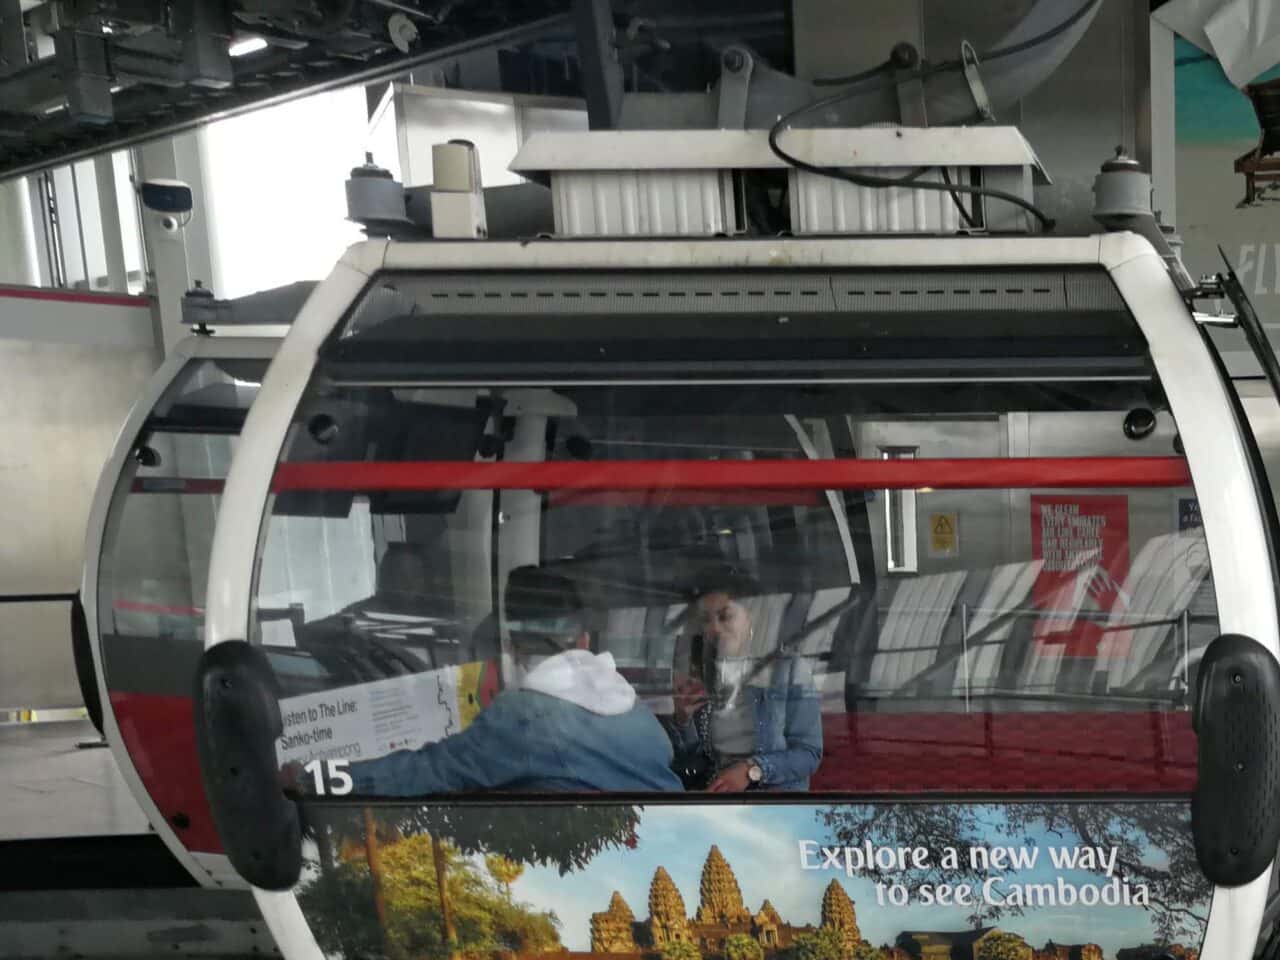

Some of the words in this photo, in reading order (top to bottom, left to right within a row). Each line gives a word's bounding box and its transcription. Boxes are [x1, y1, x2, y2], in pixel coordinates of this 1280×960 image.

[308, 707, 318, 723] to
[319, 702, 335, 719] The
[280, 727, 333, 751] Sanko-time
[304, 759, 354, 796] 15
[799, 840, 930, 878] Explore
[941, 850, 959, 870] a
[970, 845, 1039, 870] new
[1043, 845, 1118, 878] way
[877, 880, 908, 907] to
[919, 881, 973, 906] see
[983, 876, 1150, 907] Cambodia
